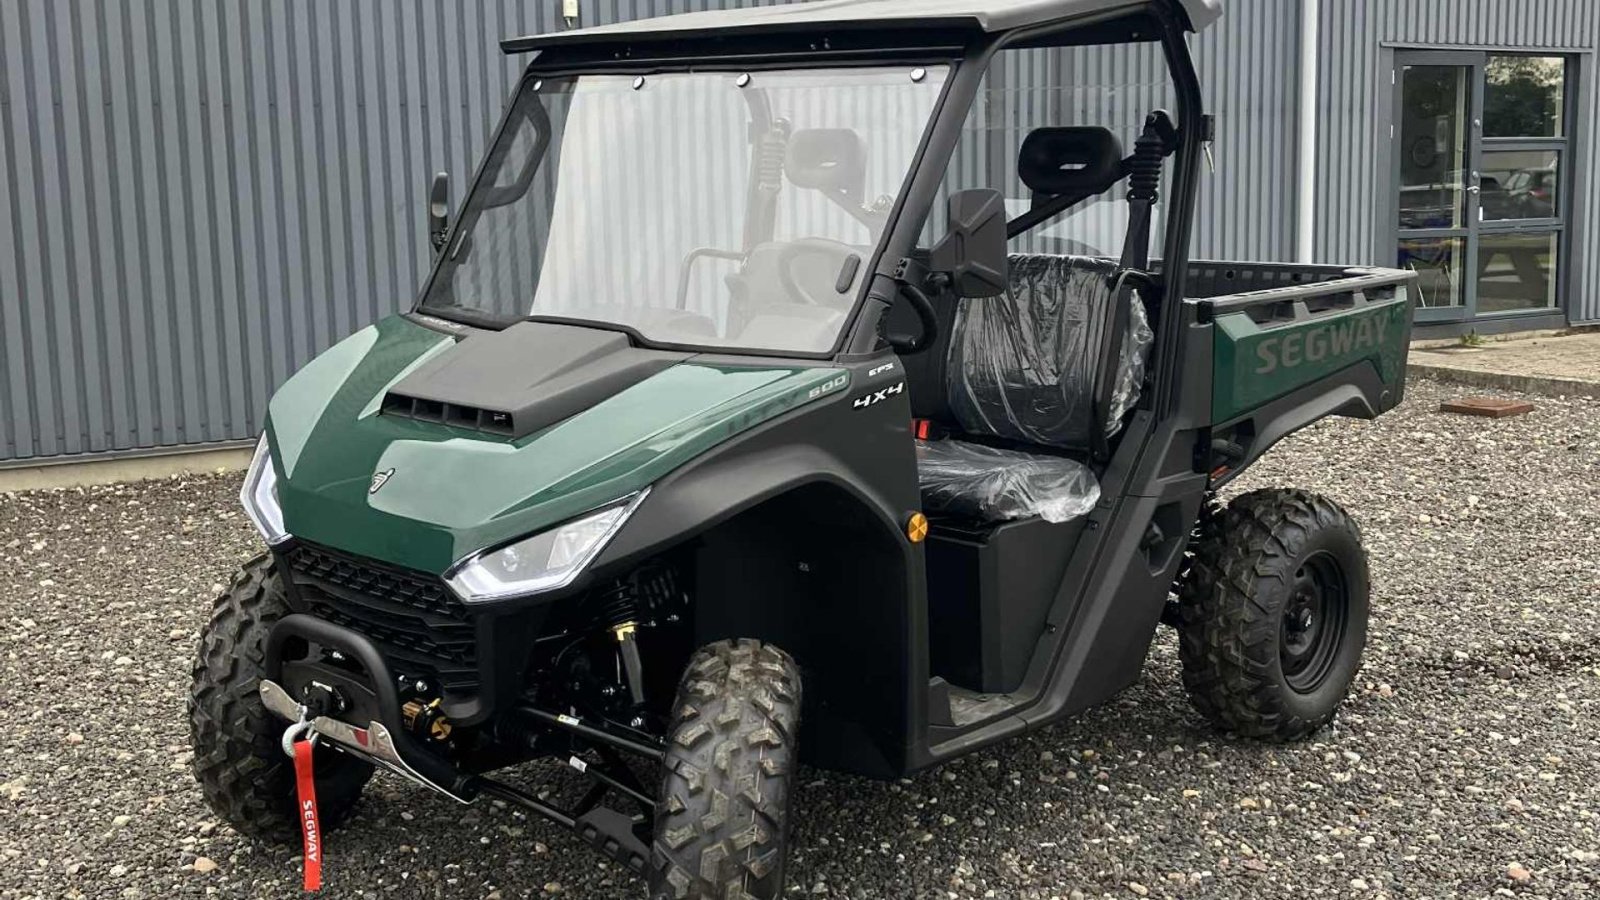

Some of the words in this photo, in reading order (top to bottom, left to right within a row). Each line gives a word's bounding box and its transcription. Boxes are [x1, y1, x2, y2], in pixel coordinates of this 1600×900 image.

[1255, 315, 1388, 374] SEGWAY
[808, 375, 847, 399] 600
[868, 362, 895, 377] EPS
[302, 800, 318, 862] SEGWAY
